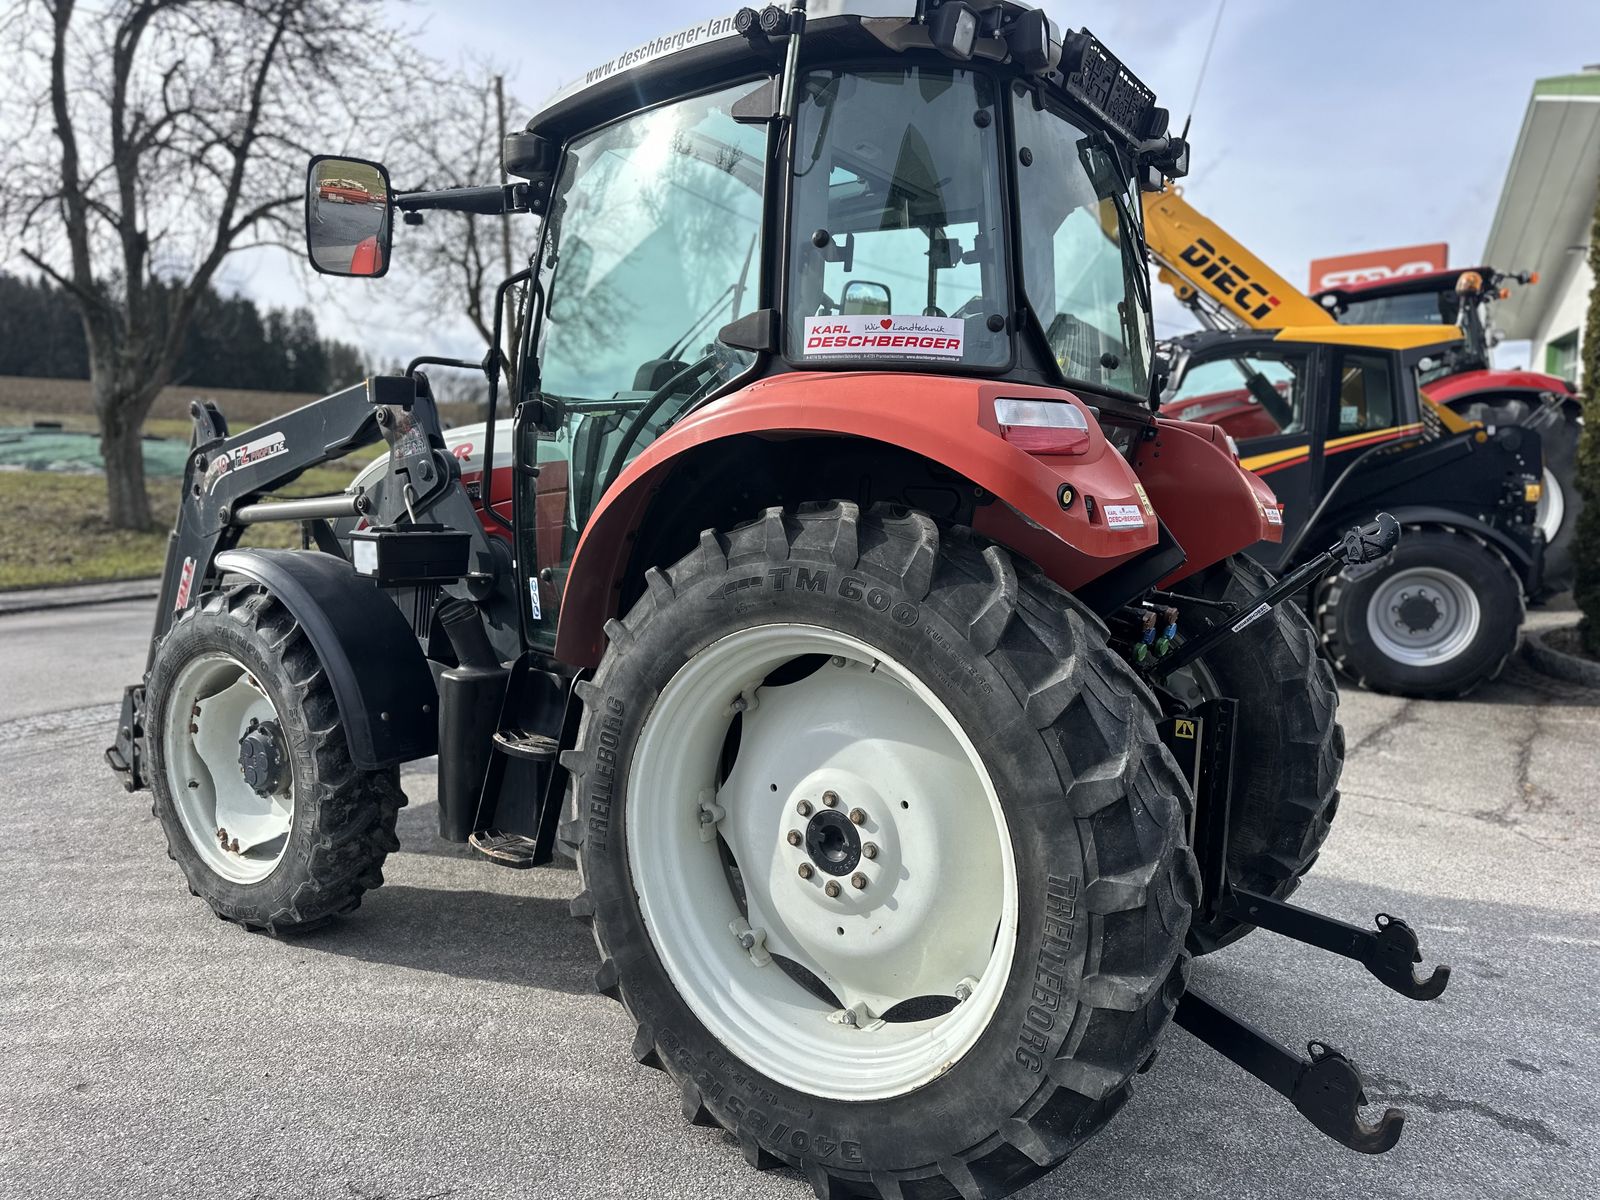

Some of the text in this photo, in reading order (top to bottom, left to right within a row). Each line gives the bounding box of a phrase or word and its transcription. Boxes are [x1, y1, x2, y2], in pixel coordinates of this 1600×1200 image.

[807, 335, 961, 350] DESCHBERGER
[811, 325, 851, 335] KARL
[864, 323, 946, 333] Wir Landtechnik
[768, 567, 919, 627] TM 600
[288, 726, 315, 866] ALLIANCE
[588, 695, 625, 851] TRELLEBORG
[1015, 873, 1079, 1074] TRELLEBORG
